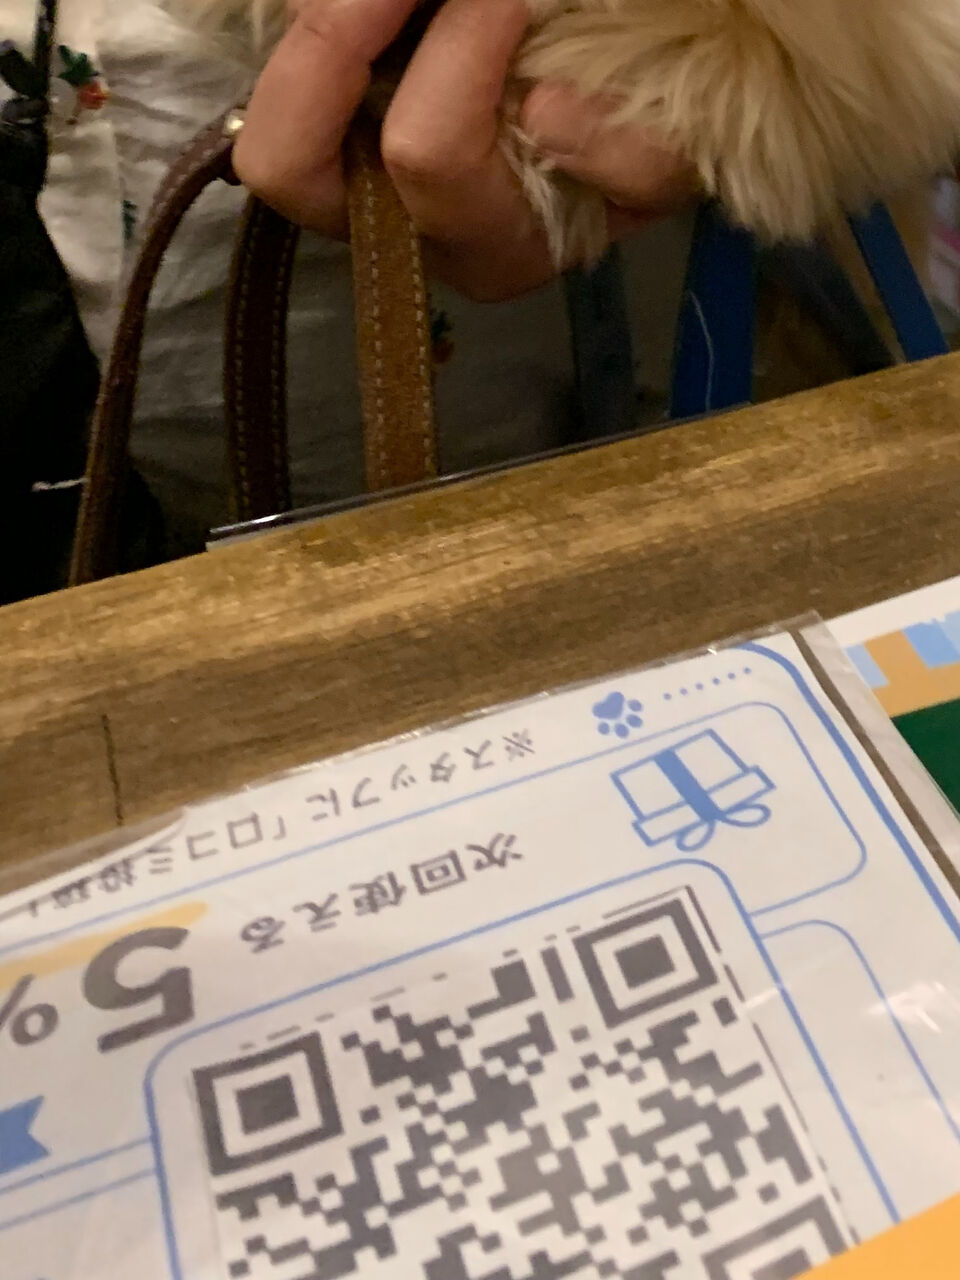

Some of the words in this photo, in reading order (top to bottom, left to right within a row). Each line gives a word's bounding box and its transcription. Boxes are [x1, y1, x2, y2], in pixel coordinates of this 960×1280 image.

[239, 833, 522, 956] 次回使える
